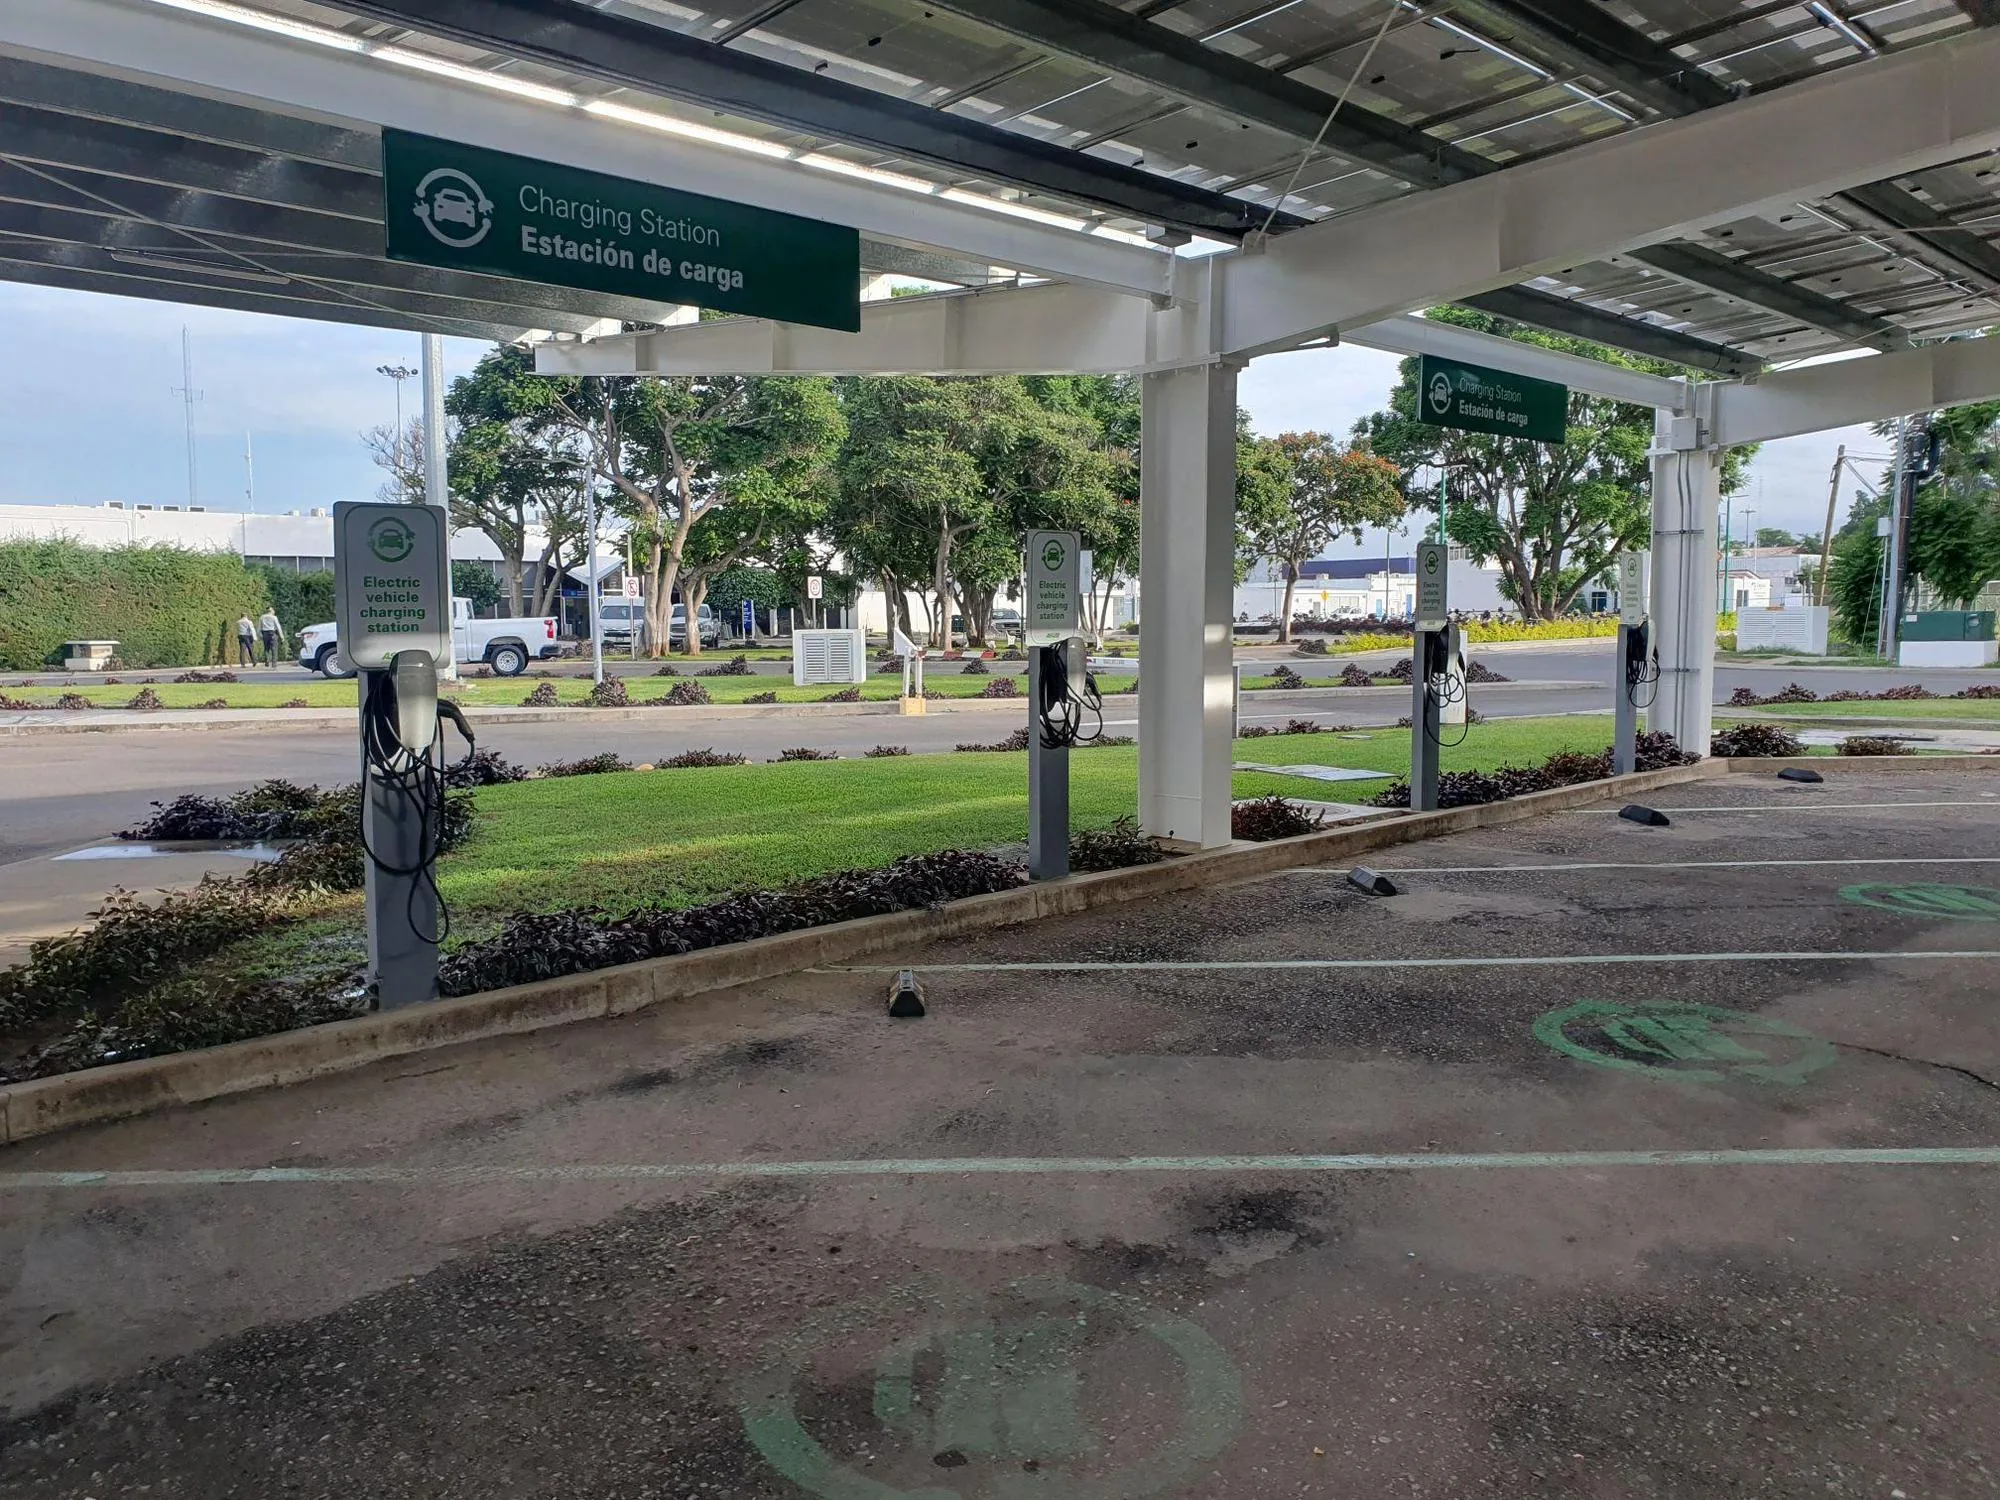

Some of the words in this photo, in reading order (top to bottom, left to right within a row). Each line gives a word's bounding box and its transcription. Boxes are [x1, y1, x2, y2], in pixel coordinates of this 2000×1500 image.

[519, 184, 631, 236] Charging
[640, 208, 720, 248] Station
[521, 224, 635, 270] Estación
[642, 248, 672, 276] de
[679, 261, 744, 292] carga
[1459, 377, 1494, 400] Charging
[1496, 384, 1522, 403] Station
[1459, 399, 1494, 420] Estación
[1495, 406, 1505, 421] de
[1507, 412, 1529, 427] carga
[363, 576, 421, 588] Electric
[1039, 580, 1067, 589] Electric
[365, 591, 420, 603] vehicle
[1039, 591, 1066, 600] vehicle
[1036, 602, 1069, 611] charging
[359, 606, 426, 620] charging
[1039, 612, 1065, 620] station
[367, 621, 420, 633] station
